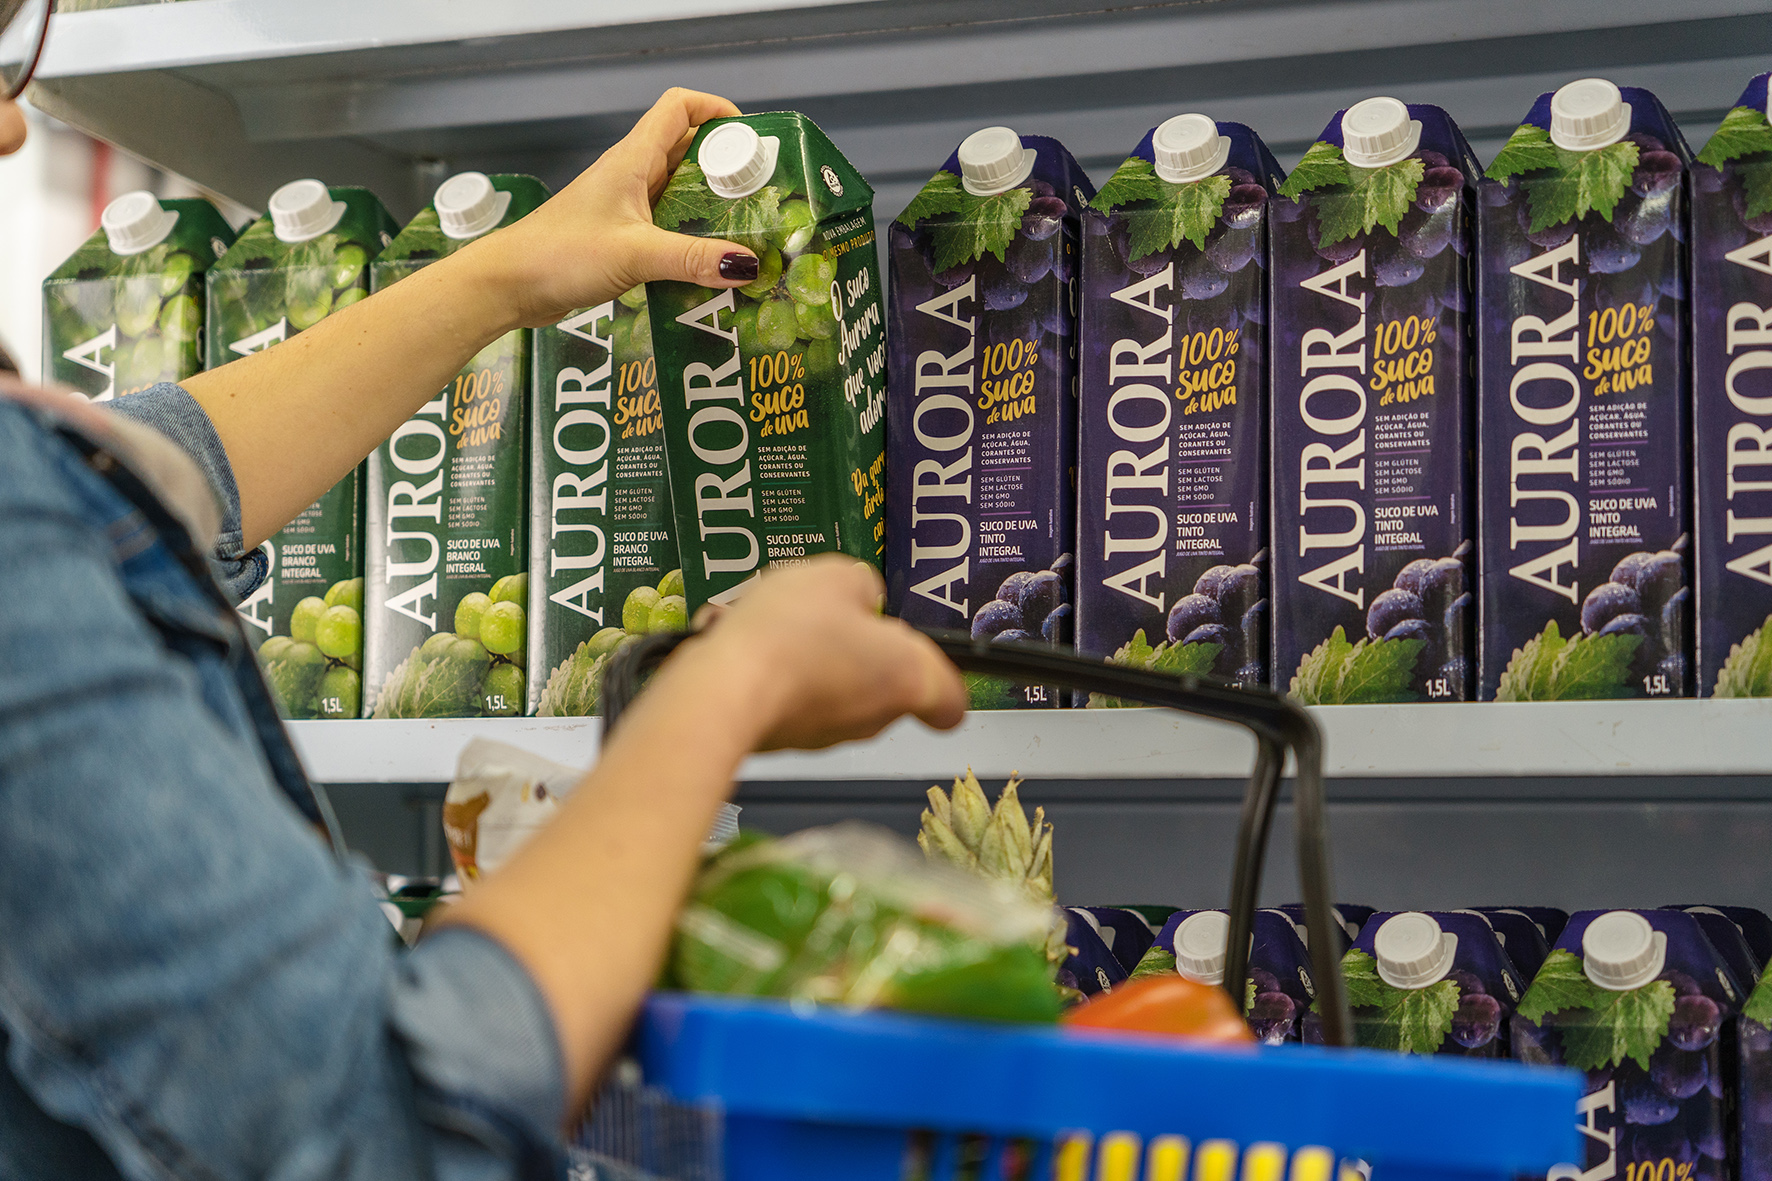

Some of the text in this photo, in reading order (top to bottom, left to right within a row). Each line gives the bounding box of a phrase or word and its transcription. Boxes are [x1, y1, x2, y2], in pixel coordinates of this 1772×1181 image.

[822, 228, 836, 240] NOVA
[830, 241, 850, 259] MESMO
[830, 267, 869, 322] O suco
[1587, 303, 1655, 347] 100%
[838, 302, 880, 365] Aurora
[1374, 315, 1436, 359] 100%
[1179, 327, 1239, 369] 100%
[981, 338, 1038, 379] 100%
[618, 356, 656, 396] 100
[750, 350, 805, 391] 100%
[1594, 364, 1653, 396] de uva
[454, 369, 504, 407] 100%
[844, 368, 865, 408] que
[1380, 375, 1435, 407] de uva
[1184, 386, 1236, 416] de uva
[986, 396, 1036, 424] de uva
[761, 408, 809, 437] de uva
[1391, 413, 1418, 422] ADIÇÃO
[1508, 233, 1580, 605] AURORA
[622, 422, 634, 439] de
[1195, 422, 1220, 431] ADIÇÃO
[1298, 249, 1367, 610] AURORA
[456, 422, 500, 450] de uva
[997, 432, 1021, 440] ADIÇÃO
[1102, 262, 1174, 613] AURORA
[910, 274, 976, 619] AURORA
[1375, 440, 1430, 449] CONSERVANTES
[1178, 448, 1231, 457] CONSERVANTES
[550, 300, 614, 626] AURORA
[981, 457, 1031, 465] CONSERVANTES
[616, 470, 663, 478] CONSERVANTES
[384, 383, 448, 632] AURO
[1589, 497, 1657, 511] SUCO DE UVA
[1177, 512, 1238, 524] SUCO DE UVA
[1375, 505, 1439, 518] SUCO DE UVA
[1589, 512, 1620, 524] TINTO
[980, 520, 1038, 531] SUCO DE UVA
[1177, 526, 1204, 537] TINTO
[1375, 520, 1404, 531] TINTO
[1589, 525, 1641, 538] INTEGRAL
[614, 531, 668, 542] SUCO DE UVA
[766, 533, 825, 545] SUCO DE UVA
[979, 534, 1006, 544] TINTO
[1374, 532, 1422, 544] INTEGRAL
[282, 544, 335, 555] SUCO DE UVA
[447, 539, 500, 550] SUCO DE UVA
[614, 544, 648, 554] BRANCO
[979, 546, 1022, 556] INTEGRAL
[1176, 539, 1222, 550] INTEGRAL
[446, 551, 480, 561] BRANCO
[768, 546, 805, 557] BRANCO
[282, 556, 315, 567] BRANCO
[613, 556, 654, 566] INTEGRAL
[282, 568, 321, 578] INTEGRAL
[446, 563, 486, 573] INTEGRAL
[1425, 678, 1451, 698] 1,5L
[1643, 675, 1670, 695] 1,5L
[1024, 685, 1047, 703] 1,5L
[321, 697, 343, 713] 1,5L
[486, 694, 507, 712] 1,5L
